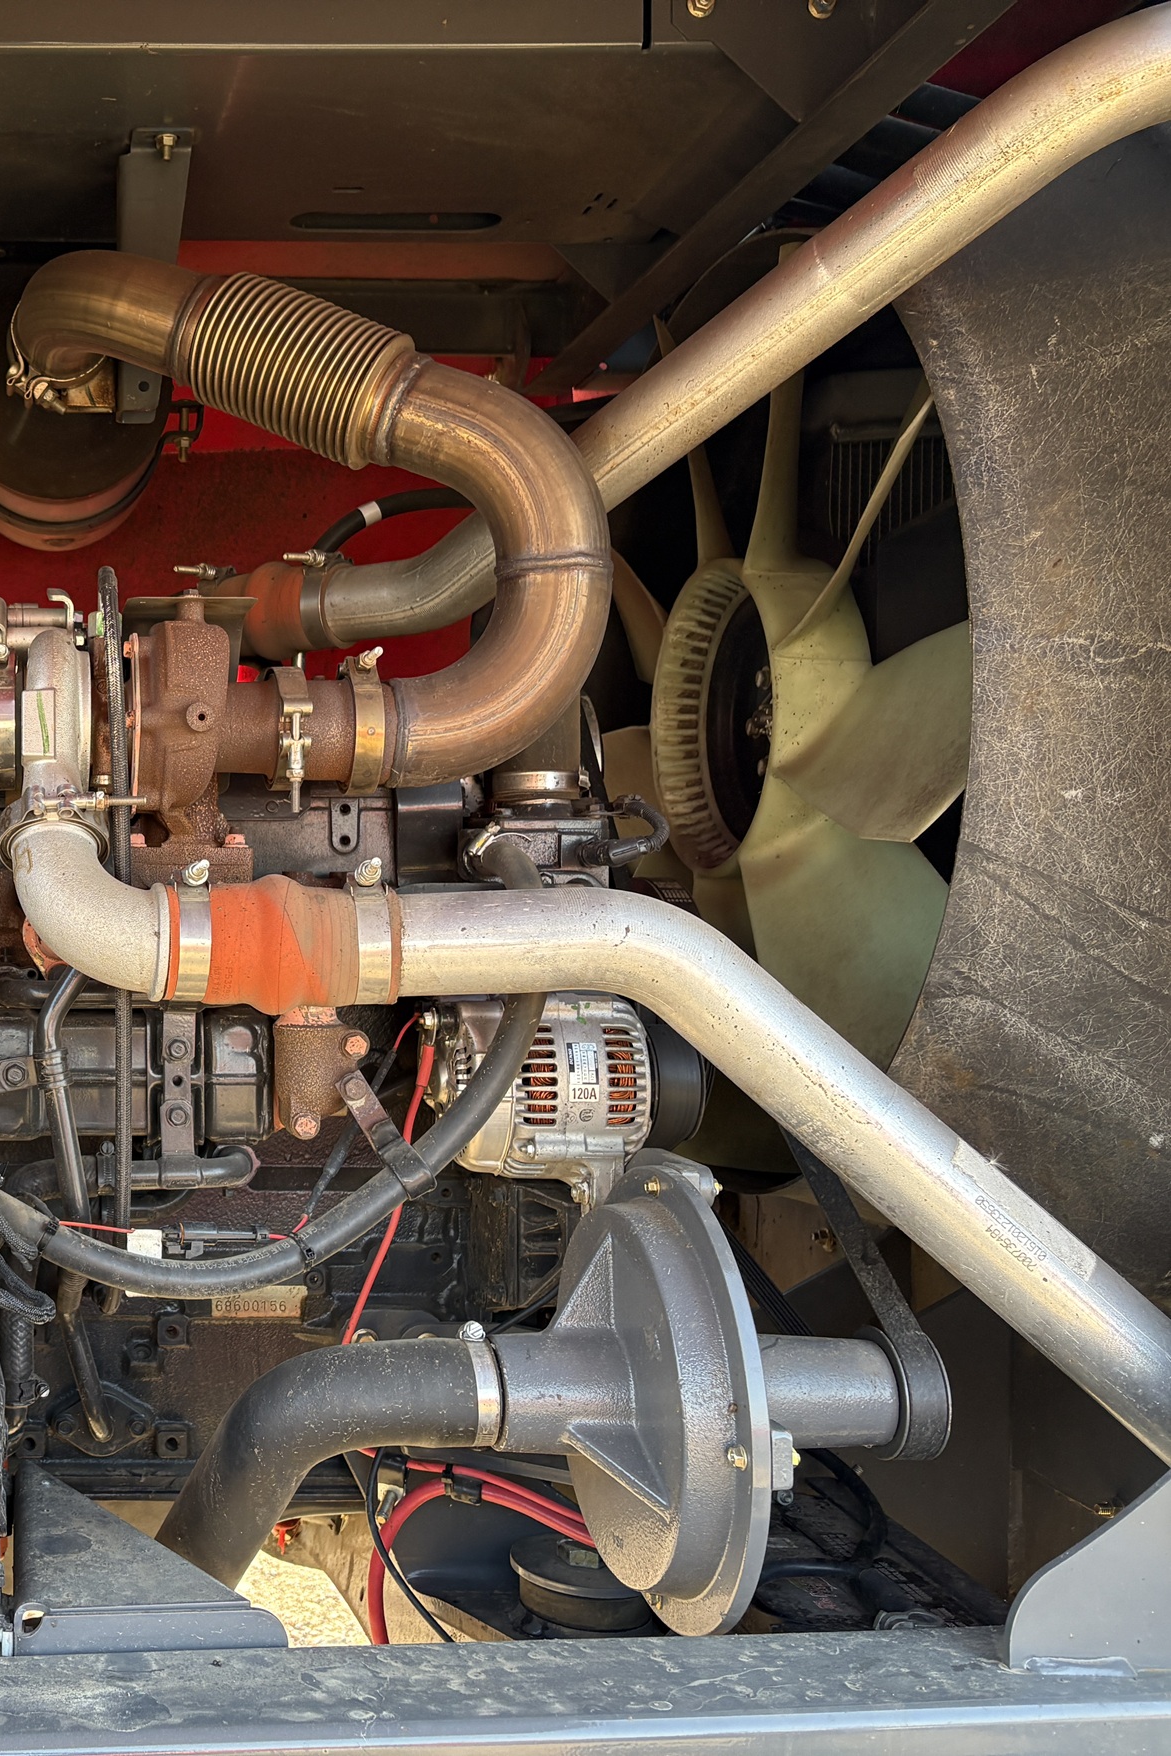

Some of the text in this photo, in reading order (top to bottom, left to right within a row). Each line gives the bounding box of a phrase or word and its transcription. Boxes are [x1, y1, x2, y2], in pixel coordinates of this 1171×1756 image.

[572, 1087, 597, 1100] 120A
[270, 1241, 290, 1256] BLUE
[215, 1299, 287, 1312] 68600156
